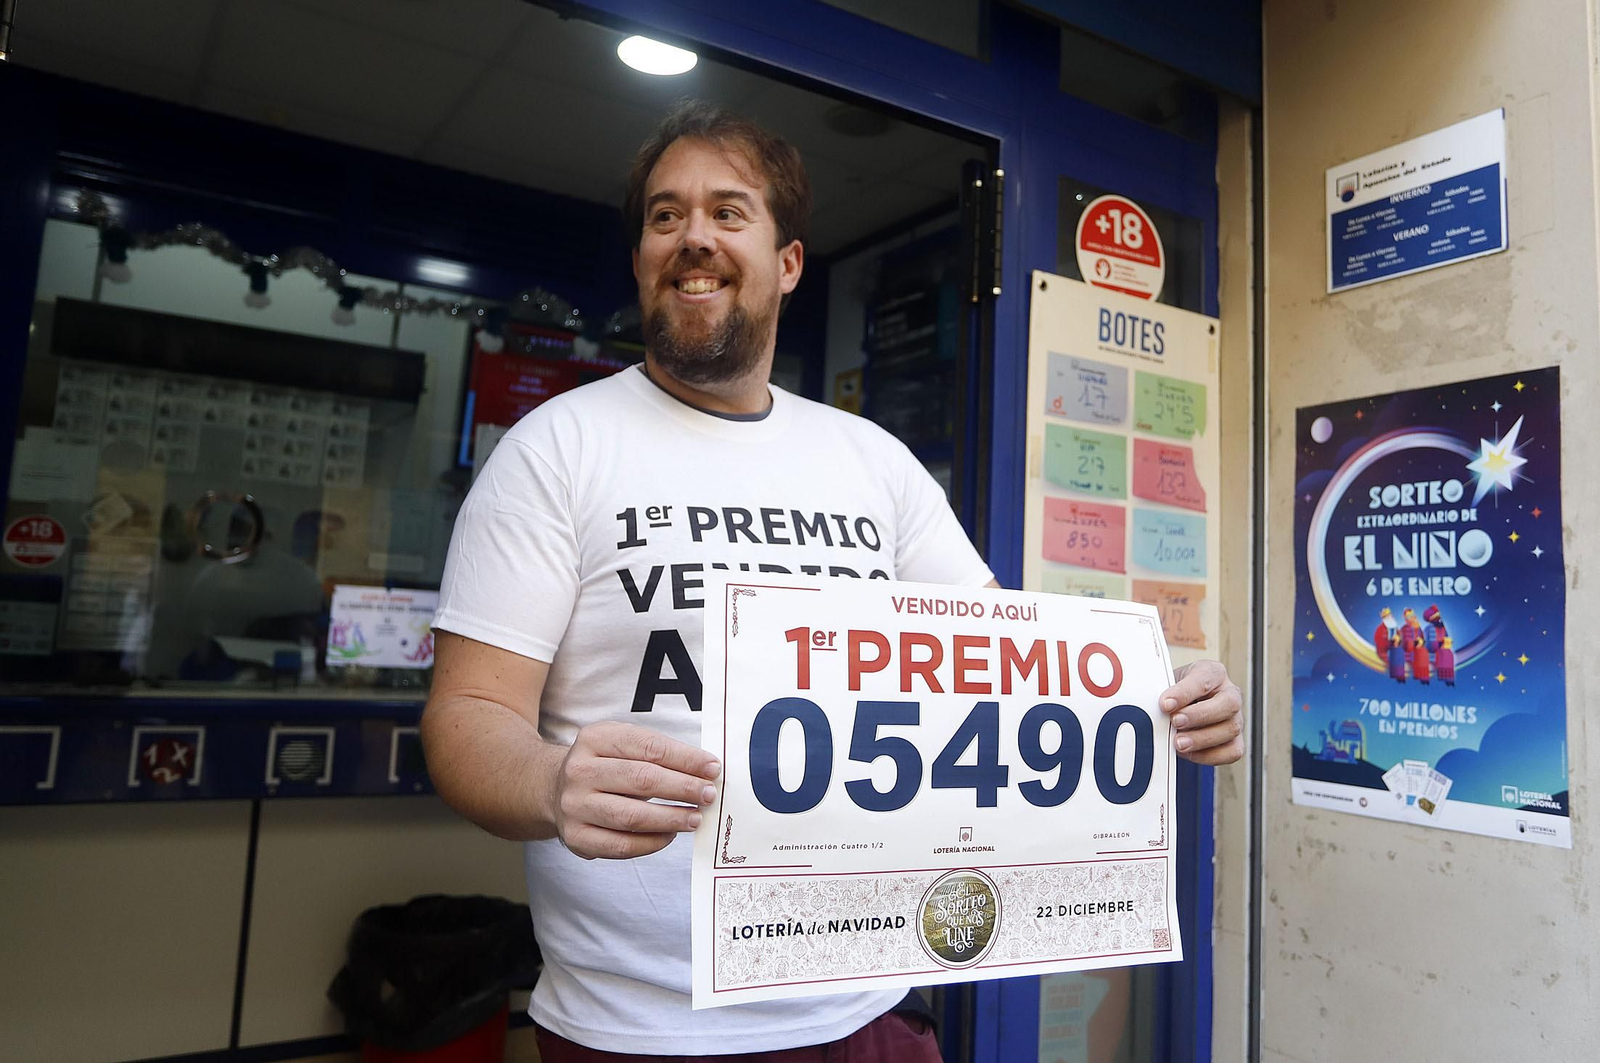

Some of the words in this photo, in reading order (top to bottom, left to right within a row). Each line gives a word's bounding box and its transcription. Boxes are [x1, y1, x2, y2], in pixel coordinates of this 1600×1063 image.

[1389, 185, 1431, 204] INVIERNO
[1095, 209, 1144, 250] +18
[1393, 224, 1430, 242] VERANO
[1099, 307, 1165, 356] BOTES
[1368, 479, 1464, 509] SORTEO
[19, 521, 53, 538] +18
[686, 505, 882, 552] PREMIO
[1356, 509, 1459, 529] EXTRAORDINARIO
[1461, 508, 1478, 522] DE
[1067, 530, 1103, 549] 850
[1344, 534, 1383, 571] EL
[1392, 528, 1494, 570] NIÑO
[1366, 577, 1378, 596] 6
[1381, 577, 1404, 596] DE
[1408, 575, 1472, 596] ENERO
[891, 596, 985, 618] VENDIDO
[991, 602, 1038, 622] AQUÍ
[847, 629, 1124, 698] PREMIO
[1359, 698, 1392, 717] 700
[1395, 701, 1478, 724] MILLONES
[1378, 718, 1396, 735] EN
[1398, 720, 1459, 740] PREMIOS
[749, 696, 1155, 814] 05490
[1519, 798, 1562, 810] NACIONAL
[772, 843, 838, 852] Administración
[841, 843, 868, 851] Cuatro
[871, 842, 884, 850] 1/2
[933, 845, 961, 854] LOTERÍA
[962, 845, 995, 853] NACIONAL
[1036, 906, 1053, 918] 22
[1058, 901, 1134, 917] DICIEMBRE
[732, 918, 805, 940] LOTERÍA
[807, 921, 825, 935] de
[828, 916, 906, 934] NAVIDAD
[946, 915, 966, 927] QUE
[942, 926, 975, 953] UNE
